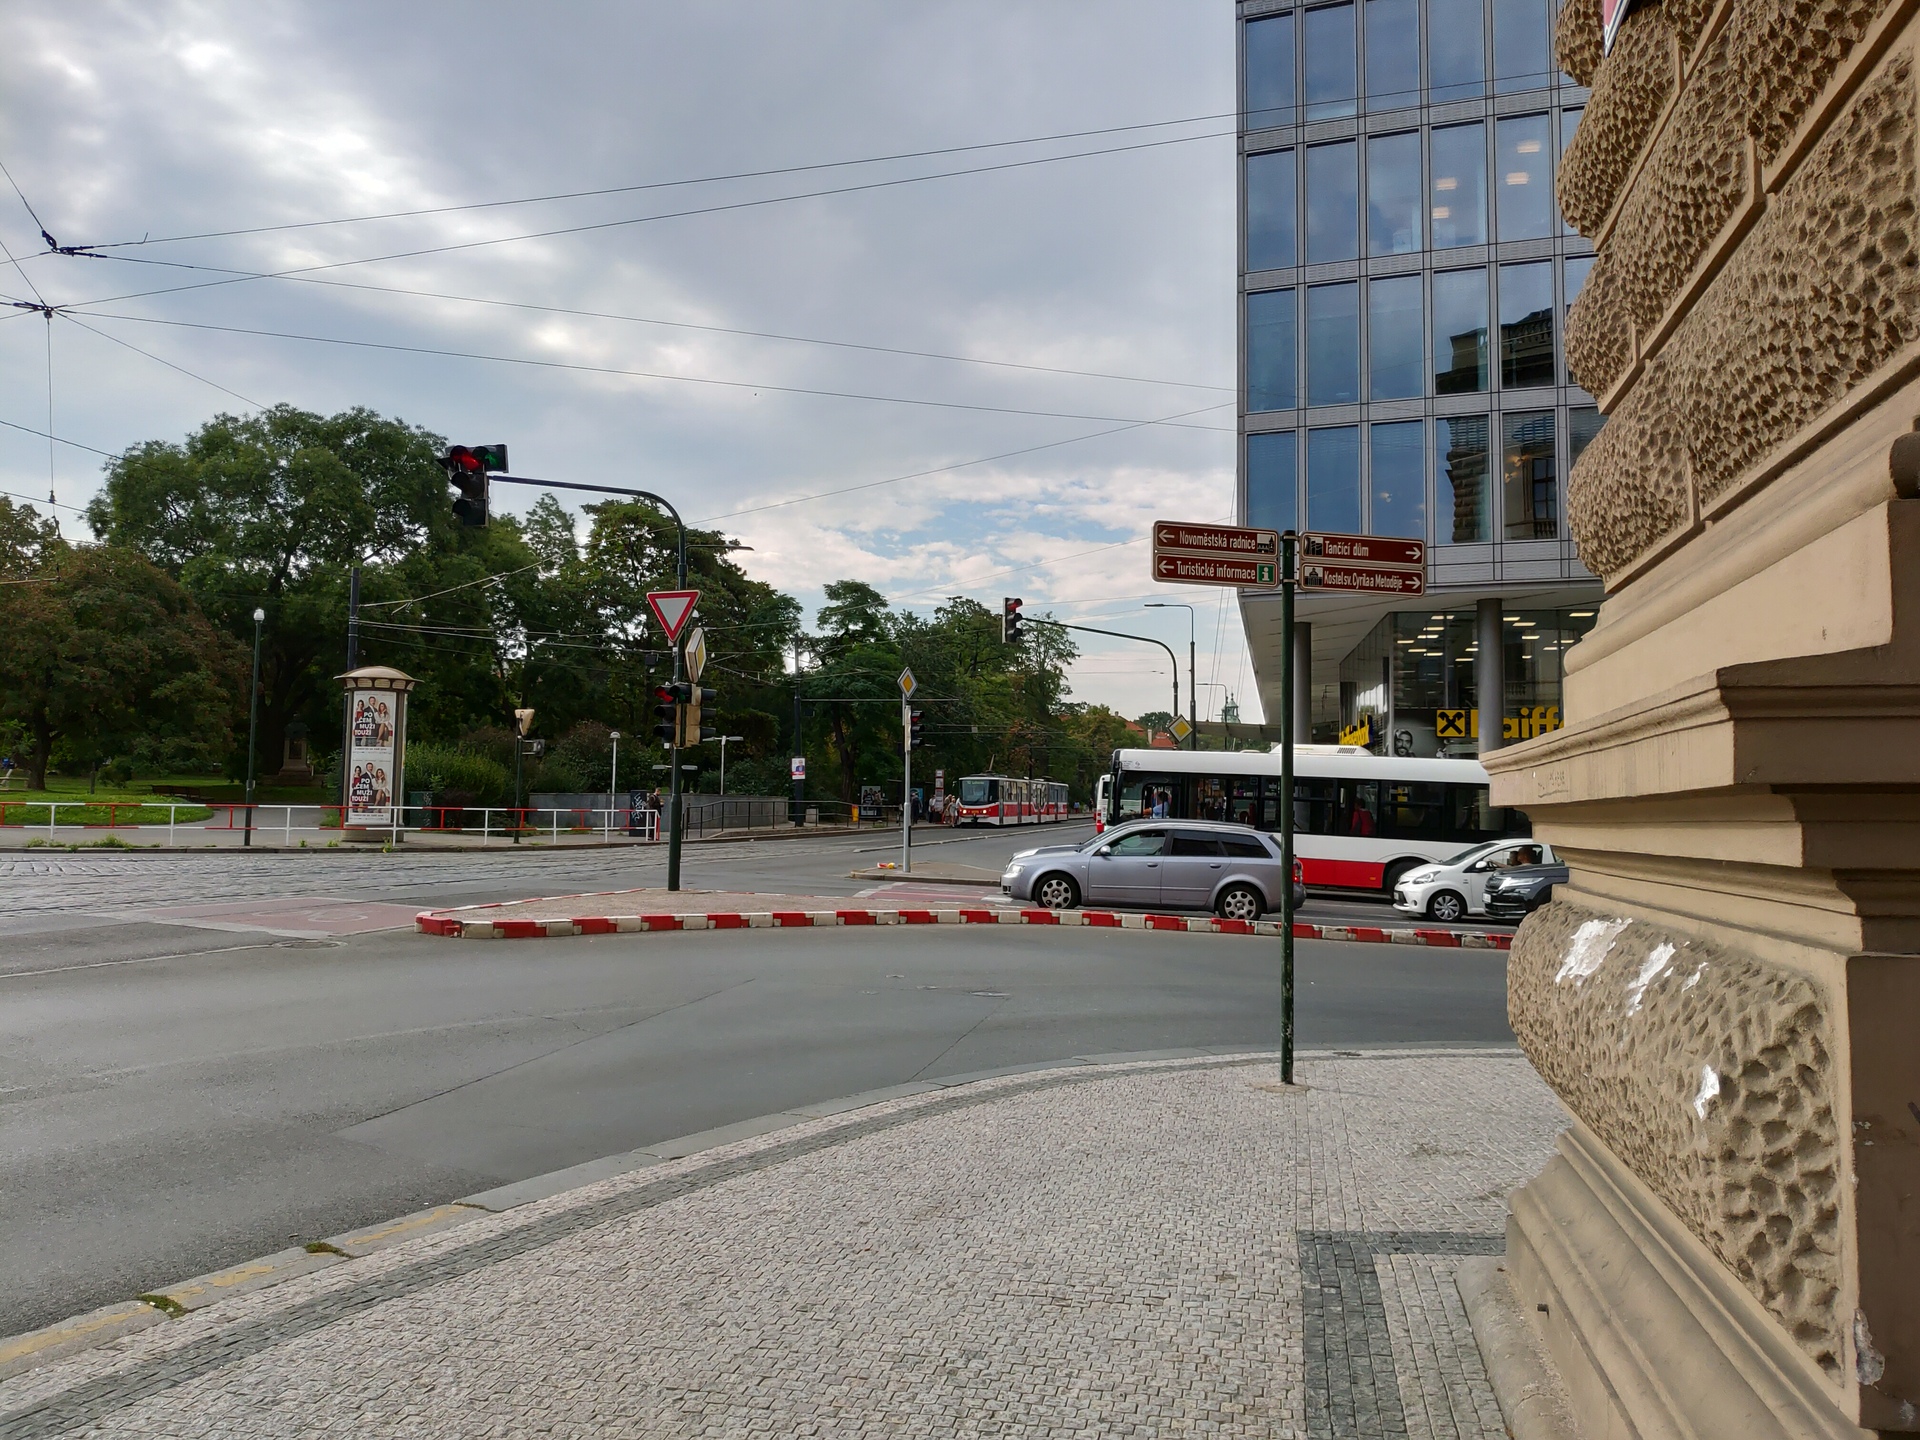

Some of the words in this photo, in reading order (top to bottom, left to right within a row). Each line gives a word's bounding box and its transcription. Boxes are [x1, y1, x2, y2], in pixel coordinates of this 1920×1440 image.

[1179, 530, 1227, 547] Novoměstská
[1229, 535, 1256, 549] radnice
[1325, 540, 1350, 555] Tančící
[1353, 542, 1369, 556] dům
[1176, 561, 1215, 577] Turistické
[1216, 564, 1256, 580] informace
[1324, 570, 1344, 585] Kostel
[1375, 573, 1403, 591] Metoděje
